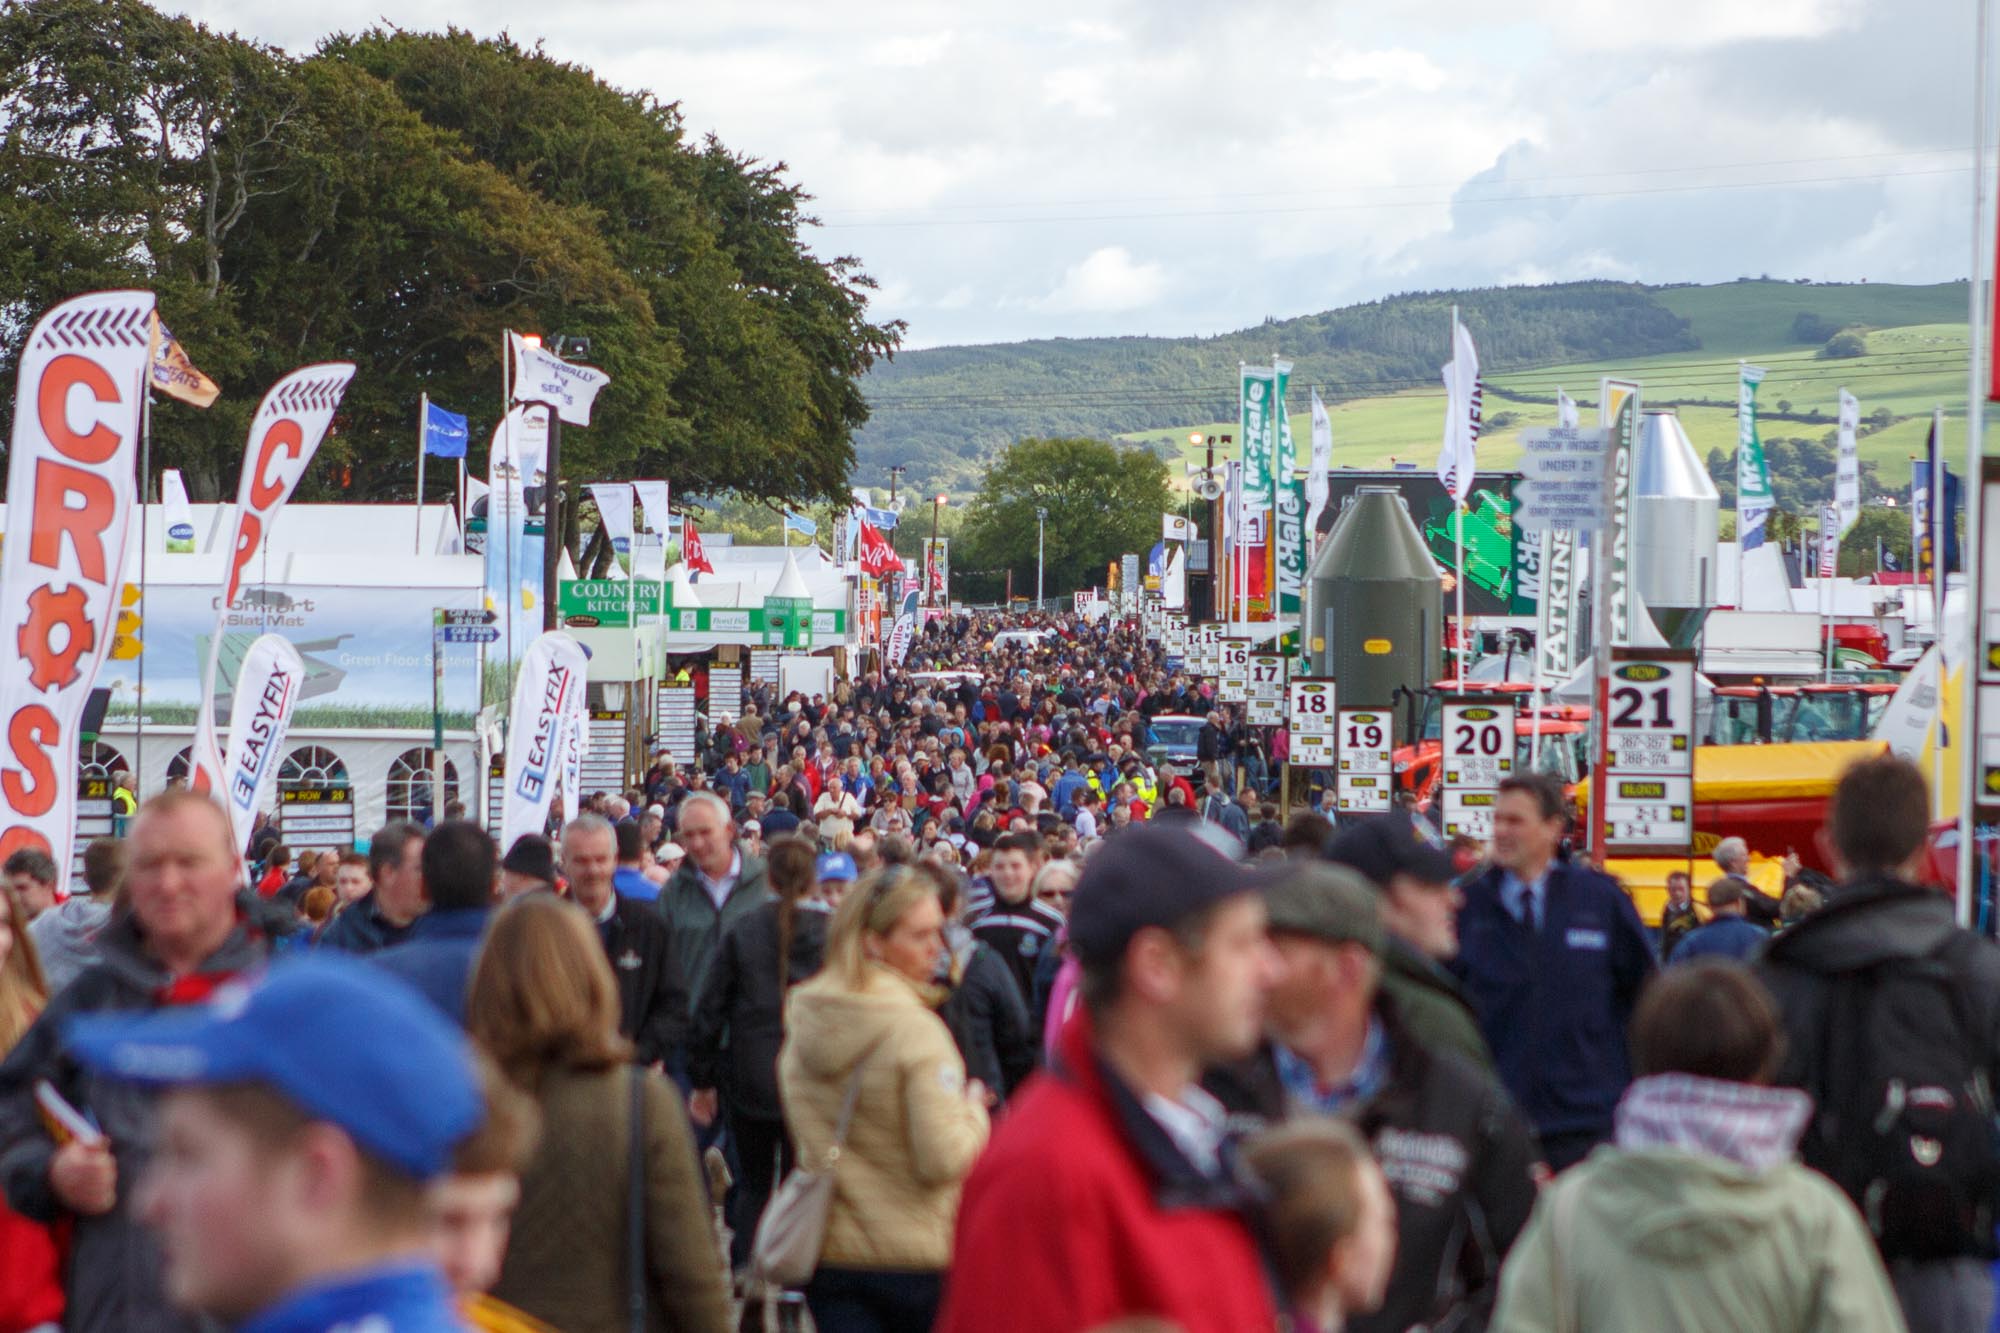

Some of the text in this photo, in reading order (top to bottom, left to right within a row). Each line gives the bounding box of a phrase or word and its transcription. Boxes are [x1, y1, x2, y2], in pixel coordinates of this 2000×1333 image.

[1244, 381, 1266, 487] McHale
[1538, 460, 1576, 472] UNDER
[1280, 495, 1301, 596] McHale
[572, 583, 660, 598] COUNTRY
[1077, 593, 1094, 602] EXIT
[587, 600, 651, 612] KITCHEN
[1543, 529, 1573, 671] ATKINS
[226, 614, 305, 627] Slat Mat
[1170, 621, 1185, 630] 13
[340, 653, 473, 667] Green Floor Sstem
[1225, 650, 1246, 664] 16
[1254, 667, 1278, 682] 17
[1626, 666, 1660, 680] ROW
[1297, 694, 1326, 713] 18
[1612, 686, 1674, 728] 21
[241, 662, 288, 773] EASYFIX
[528, 659, 565, 767] EASYFIX
[1347, 725, 1382, 748] 19
[1455, 724, 1501, 755] 20
[87, 781, 106, 796] 21
[298, 789, 345, 800] ROW 20
